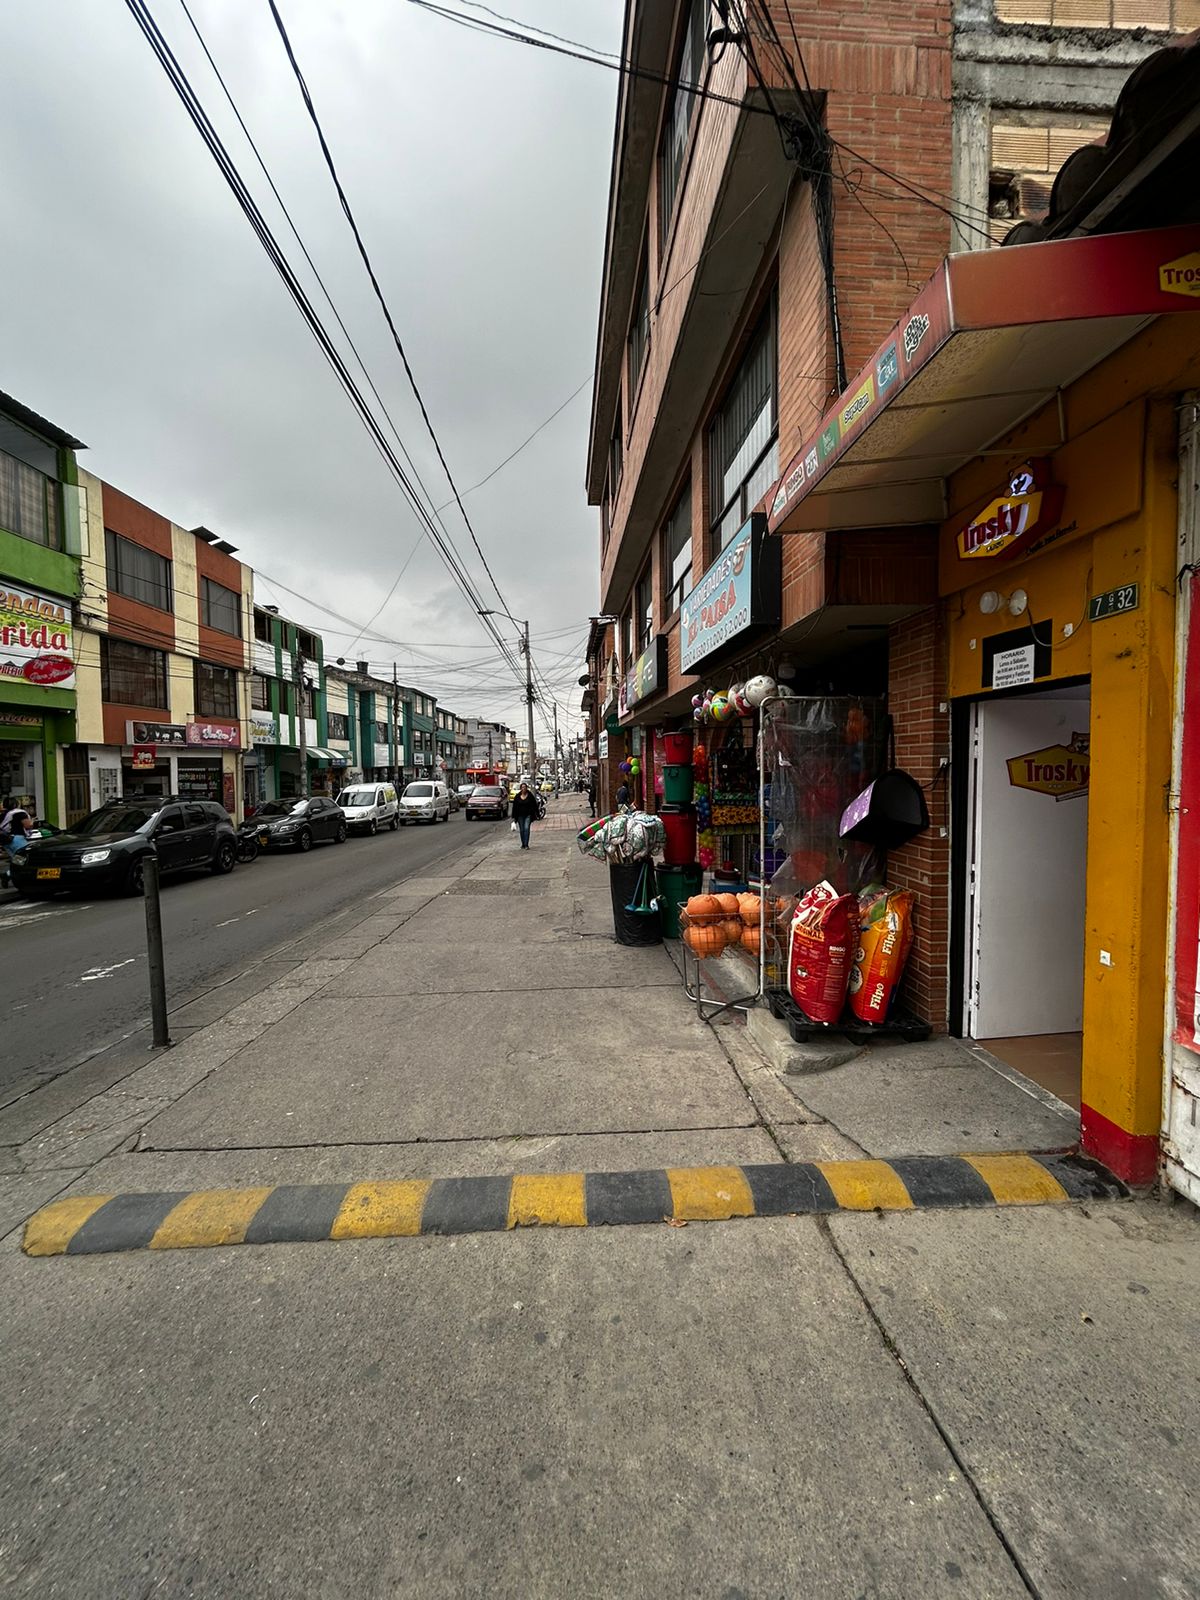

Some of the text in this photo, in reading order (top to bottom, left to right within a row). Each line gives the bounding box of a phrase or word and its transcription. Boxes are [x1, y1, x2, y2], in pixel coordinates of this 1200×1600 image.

[963, 502, 1031, 554] Trosky
[1095, 597, 1103, 616] 7
[1117, 587, 1133, 609] 32
[1, 621, 68, 651] rida
[1001, 649, 1025, 660] HORARIO
[1024, 758, 1090, 785] Trosky
